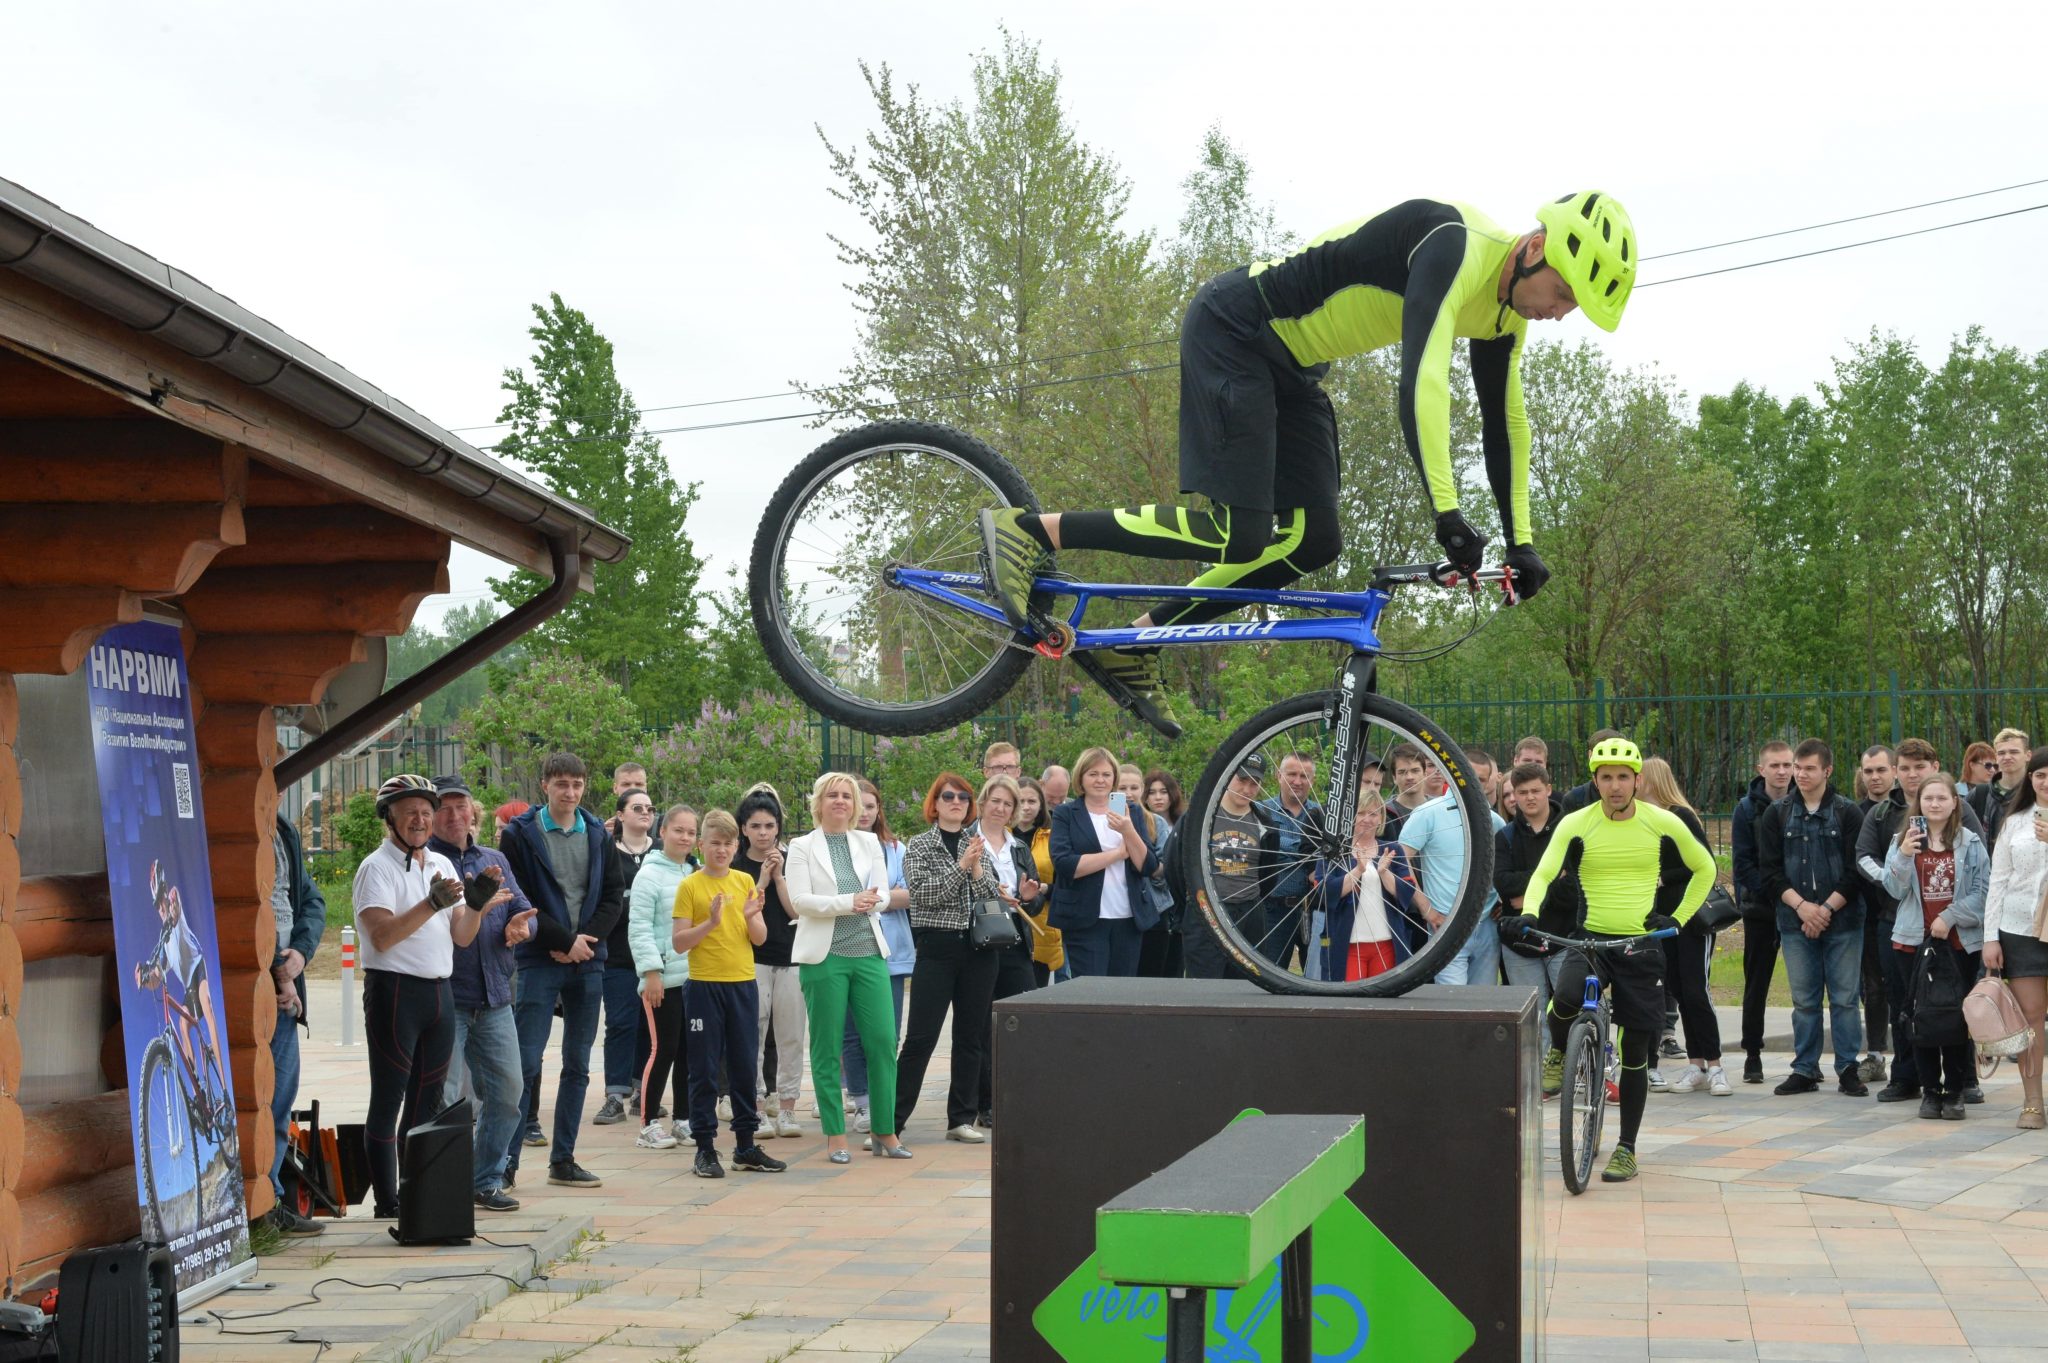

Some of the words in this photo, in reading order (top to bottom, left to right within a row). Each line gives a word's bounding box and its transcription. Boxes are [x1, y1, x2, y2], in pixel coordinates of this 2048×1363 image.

[1278, 594, 1327, 603] TOMORROW
[90, 645, 181, 698] НАРВМИ
[96, 706, 109, 721] НКО
[153, 711, 185, 731] Ассоциация
[102, 730, 130, 747] Развития
[1324, 688, 1353, 836] HASHTAGG
[1419, 729, 1467, 788] MAXXIS
[690, 1018, 704, 1032] 29
[168, 1233, 194, 1252] arvmi.ru
[204, 1239, 232, 1263] 291-29-78
[1079, 1285, 1160, 1323] velo
